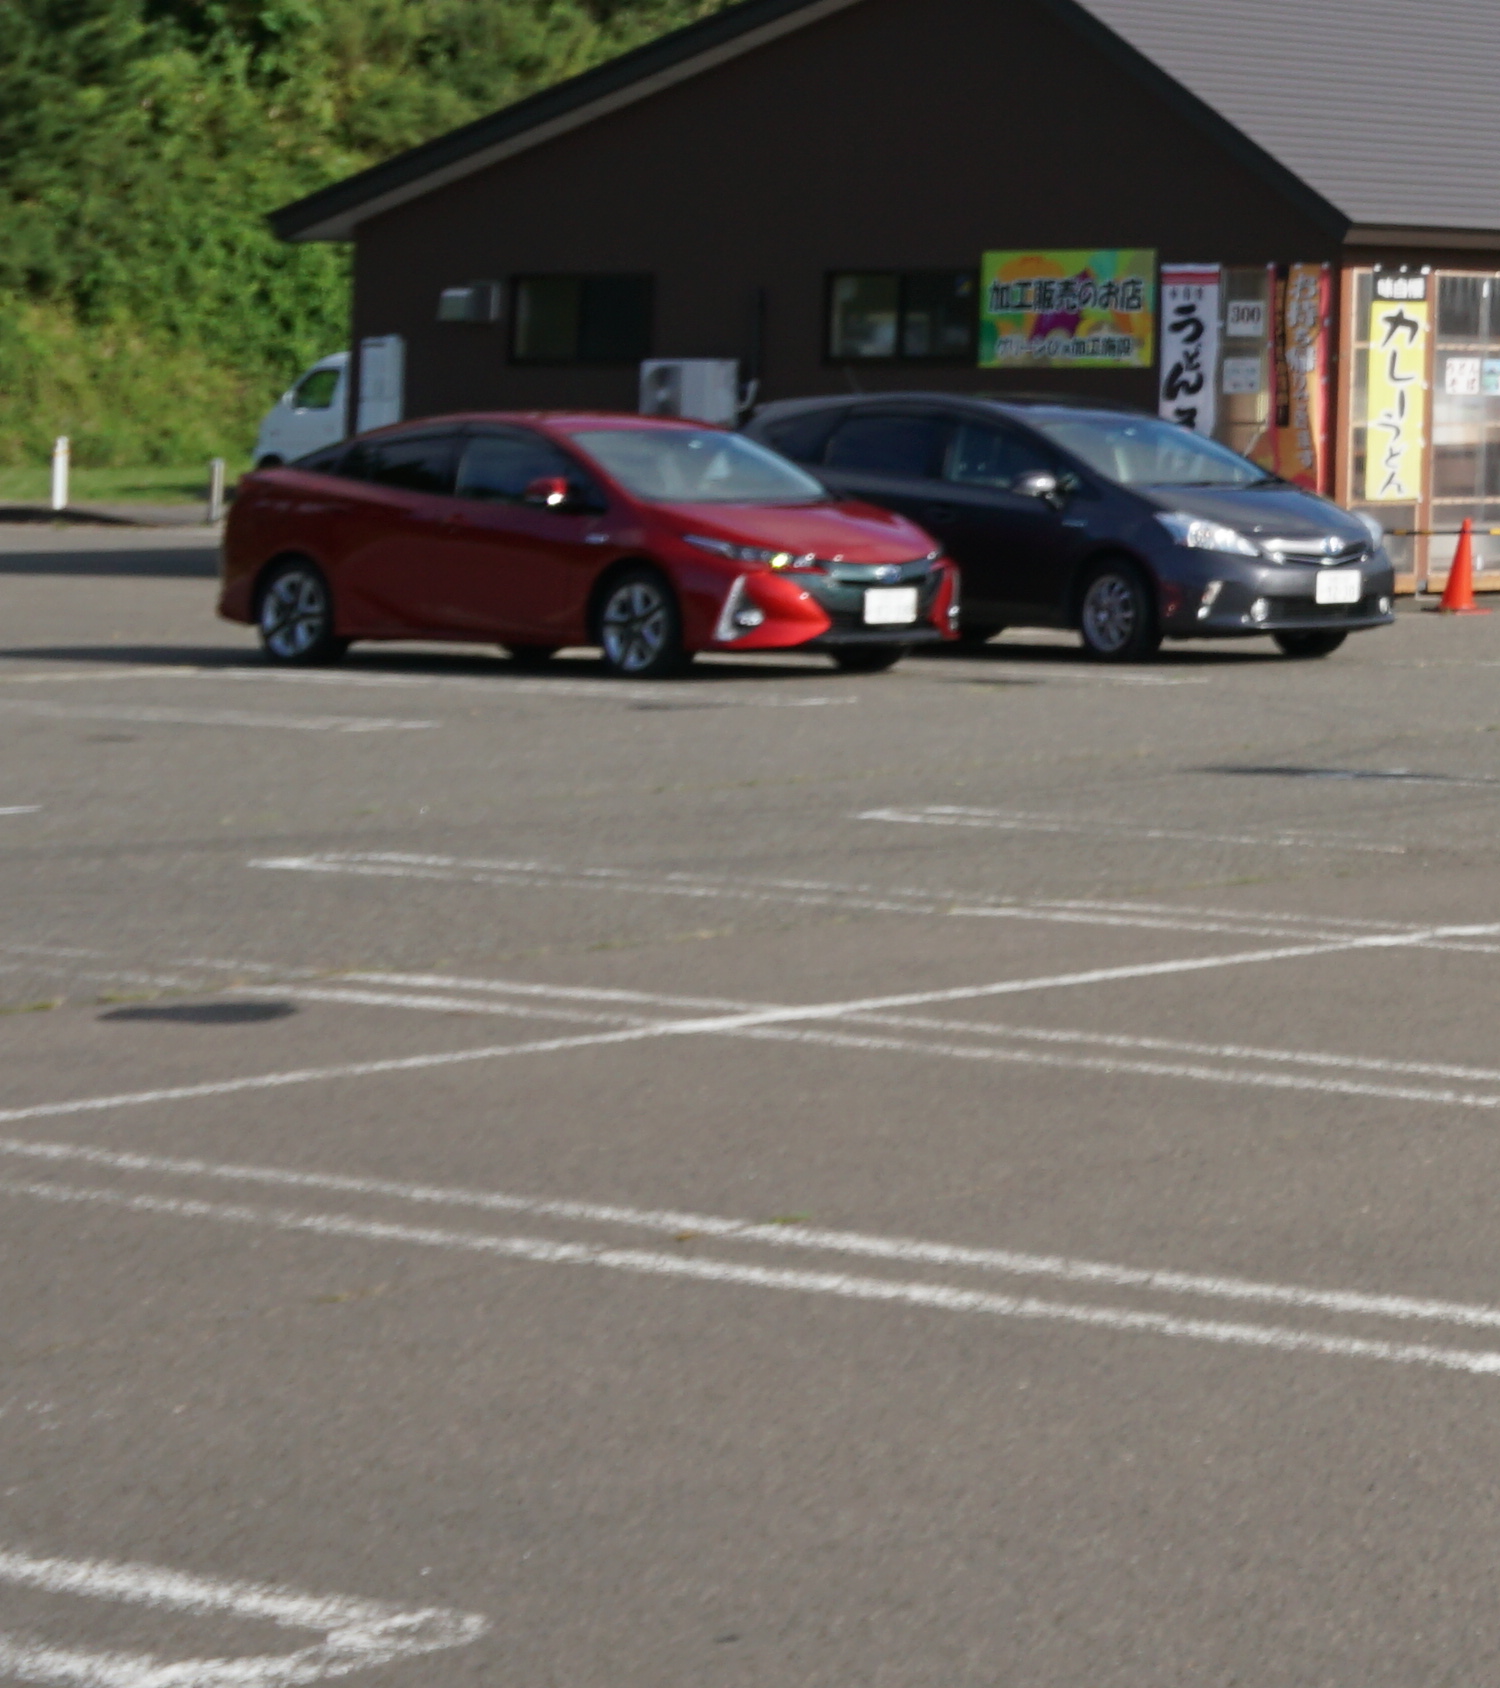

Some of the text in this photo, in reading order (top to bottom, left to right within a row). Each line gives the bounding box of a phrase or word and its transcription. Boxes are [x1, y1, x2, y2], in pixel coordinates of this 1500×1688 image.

[989, 278, 1144, 312] 加工販売のお店
